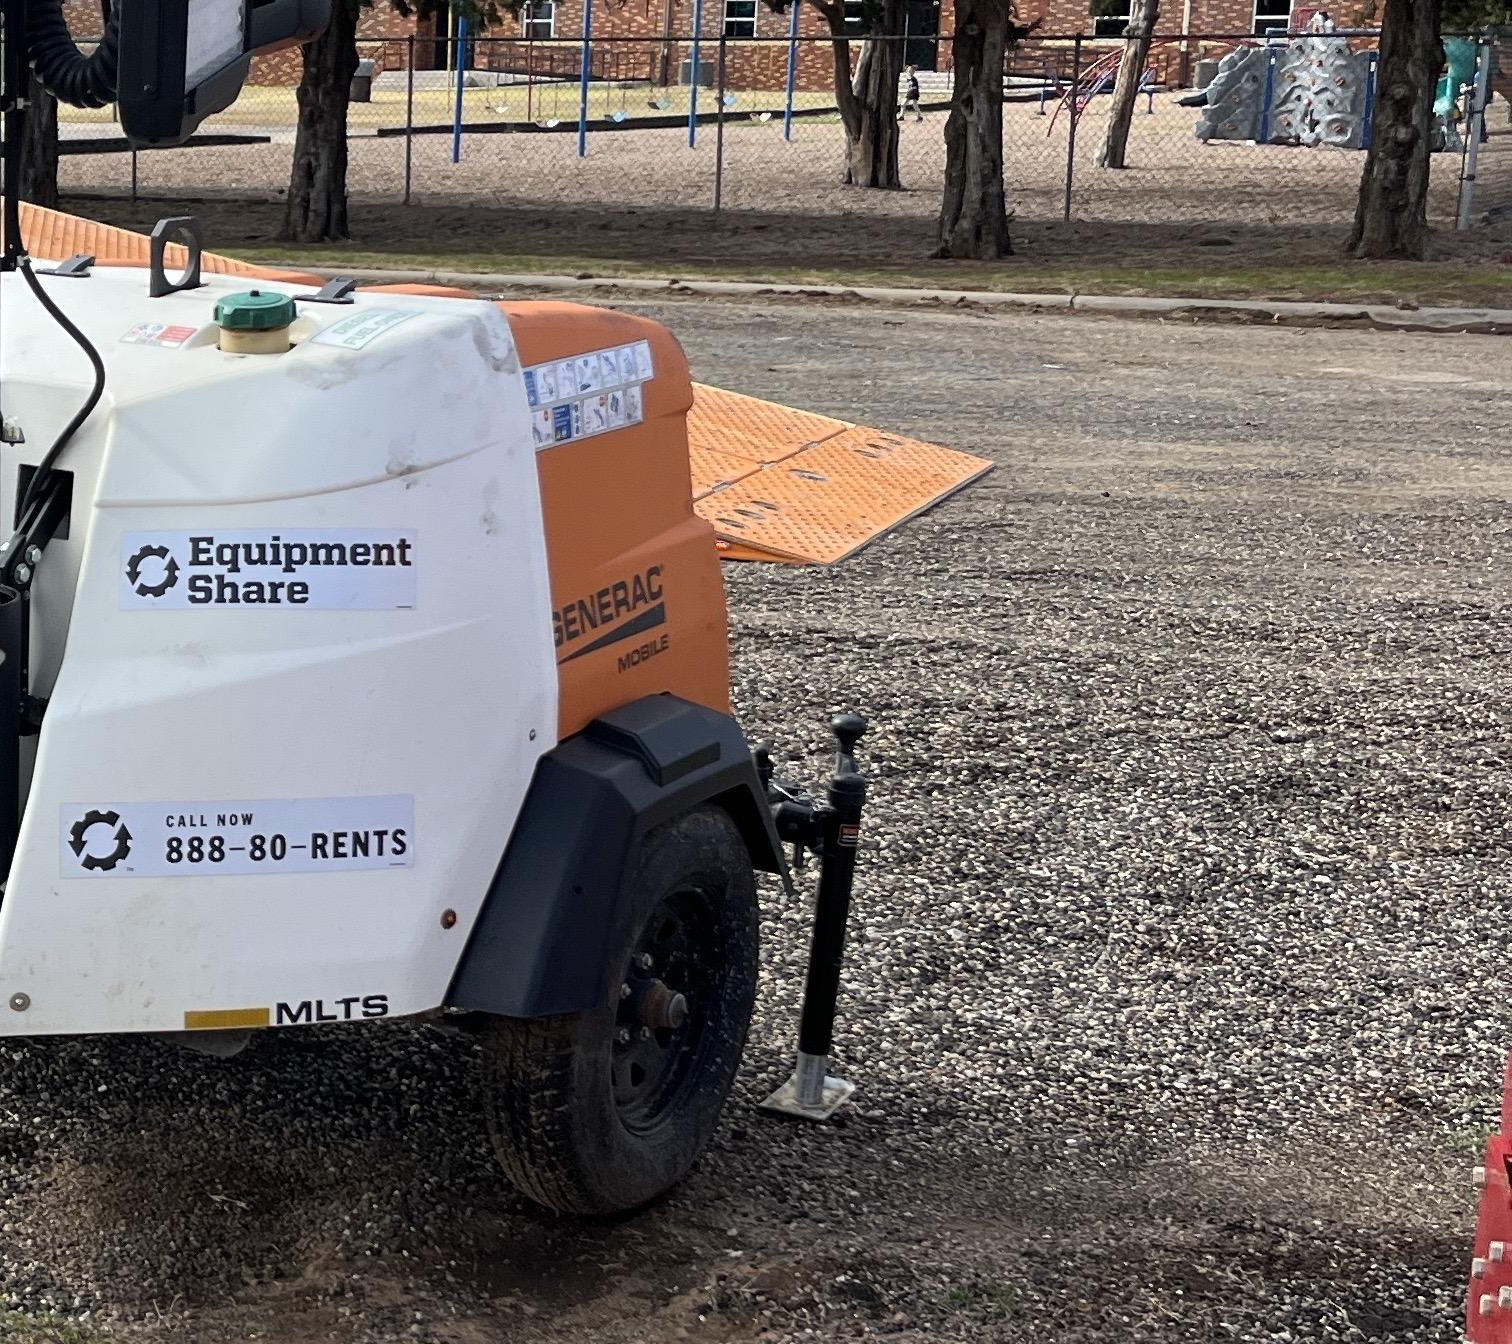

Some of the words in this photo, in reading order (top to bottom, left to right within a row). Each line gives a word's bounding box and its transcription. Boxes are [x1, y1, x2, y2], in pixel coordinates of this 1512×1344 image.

[188, 535, 412, 573] Equipment
[187, 574, 309, 604] Share
[552, 565, 663, 648] GENERAC
[616, 633, 669, 674] MOBILE
[165, 814, 208, 828] CALL
[216, 813, 254, 826] NOW
[165, 828, 407, 864] 888-80-RENTS
[275, 994, 389, 1025] MLTS
